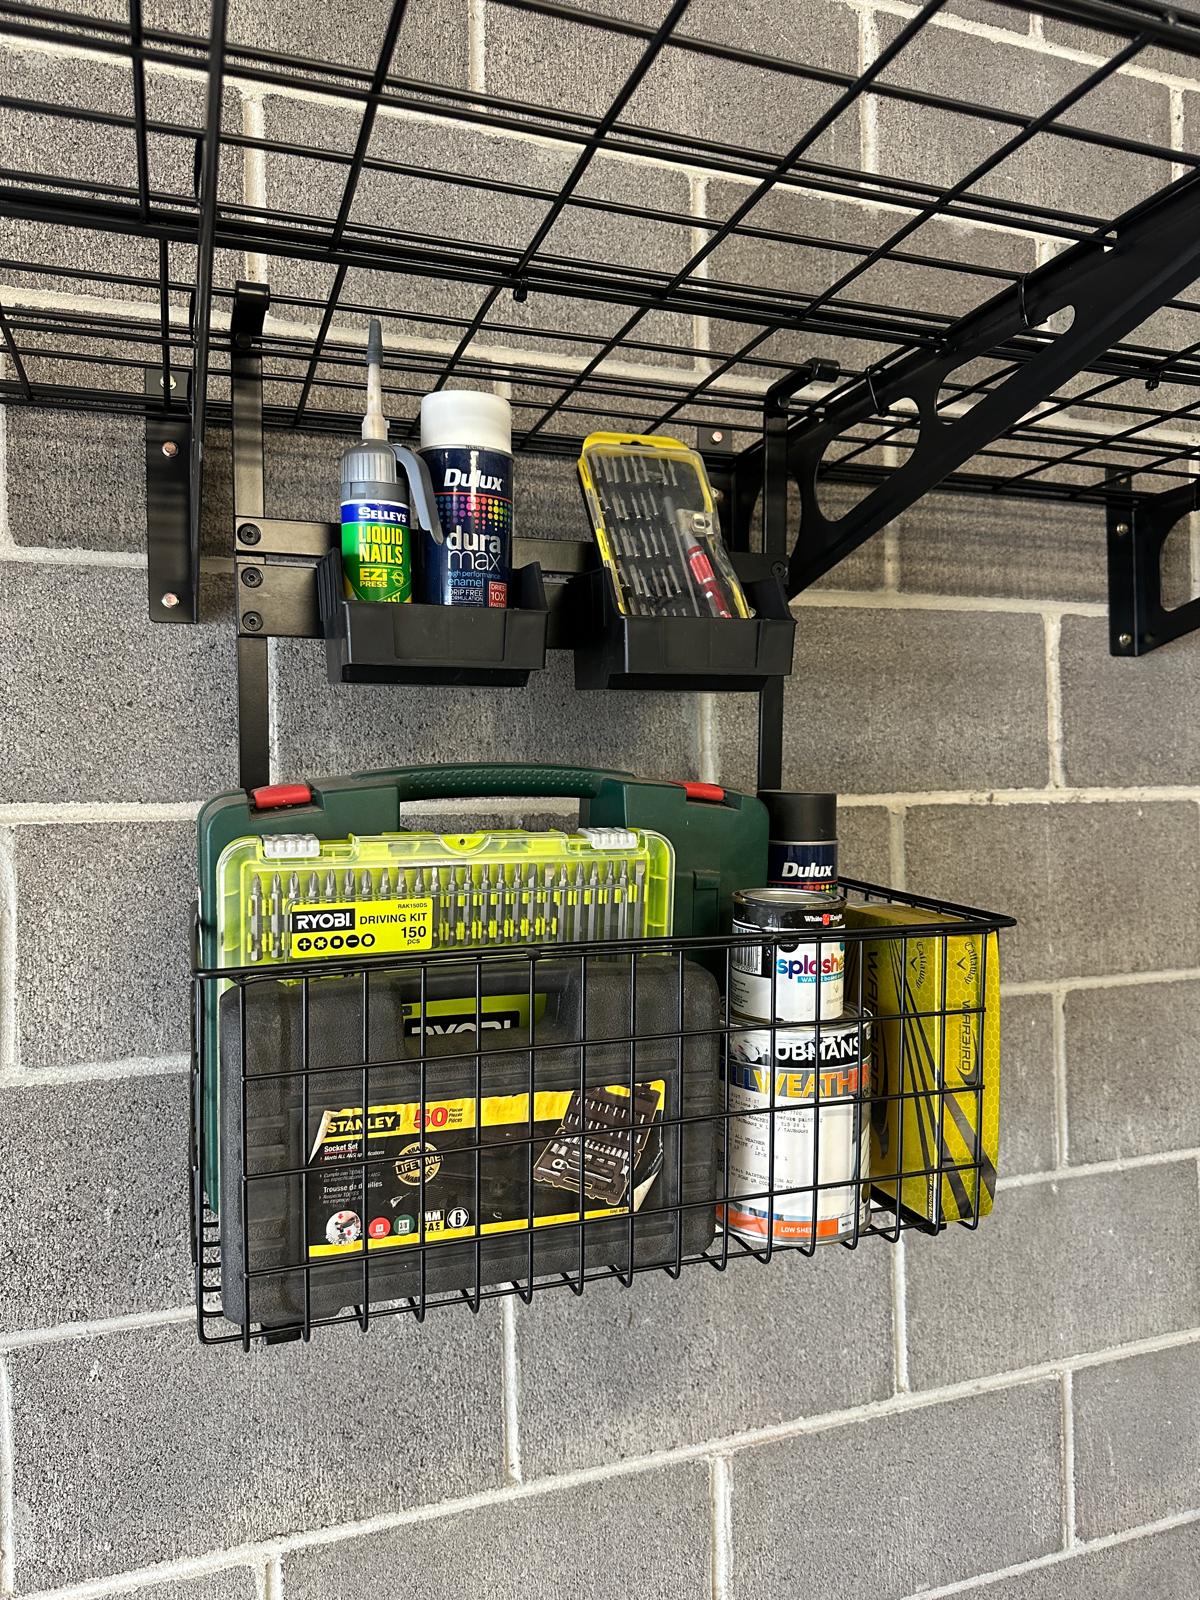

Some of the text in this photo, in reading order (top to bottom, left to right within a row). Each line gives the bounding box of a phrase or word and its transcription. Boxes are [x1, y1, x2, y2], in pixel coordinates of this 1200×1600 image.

[443, 467, 503, 491] Dulux
[358, 506, 407, 523] SELLEYS
[359, 526, 403, 545] LIQUID
[446, 525, 501, 553] dura
[360, 544, 403, 564] NAILS
[447, 550, 501, 572] max
[447, 578, 484, 588] enamel
[465, 589, 483, 597] FREE
[491, 591, 505, 602] 10X
[781, 862, 833, 877] Dulux
[296, 912, 352, 930] RYOBI
[359, 912, 428, 925] DRIVING KIT
[401, 926, 427, 938] 150
[916, 941, 927, 989] Callaway
[964, 941, 979, 985] Callaway
[413, 1107, 449, 1129] 50
[324, 1142, 359, 1153] Socket Set
[455, 1211, 461, 1226] 6
